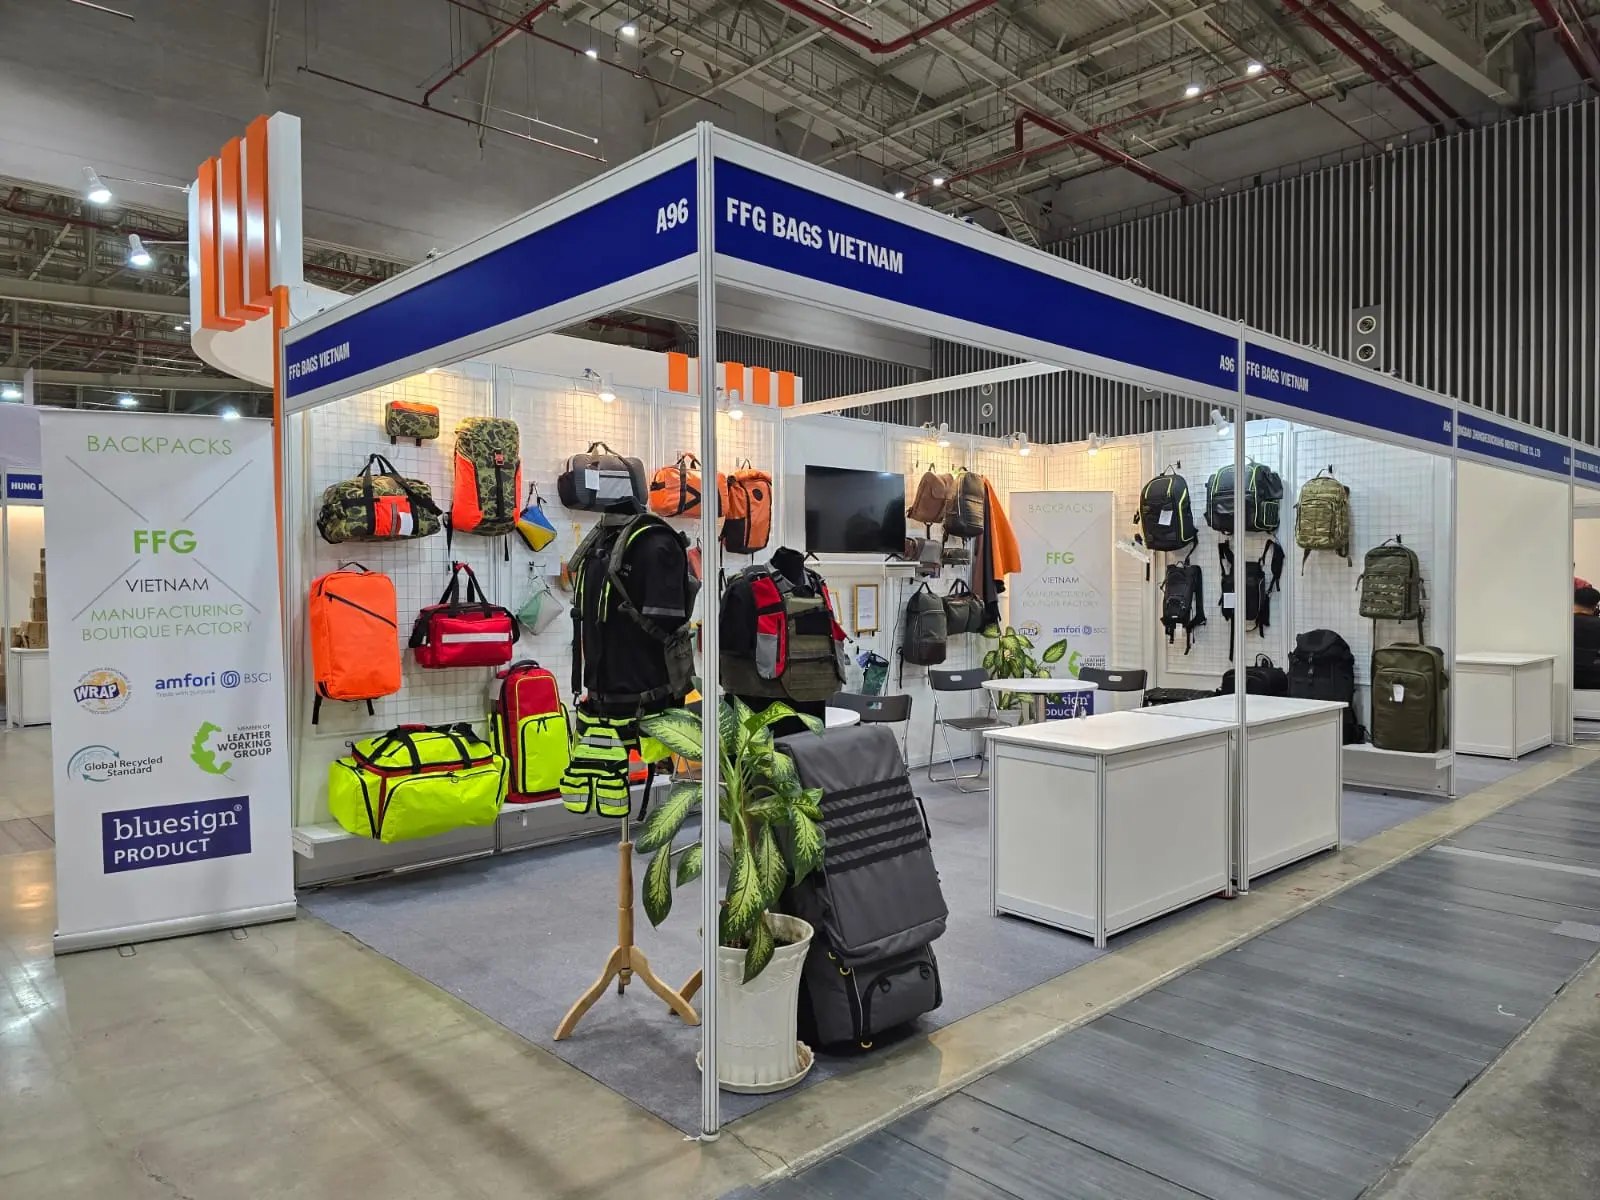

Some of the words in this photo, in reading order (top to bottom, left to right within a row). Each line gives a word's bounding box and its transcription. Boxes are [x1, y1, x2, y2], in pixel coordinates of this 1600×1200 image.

[655, 198, 689, 234] A96
[726, 197, 767, 233] FFG
[772, 212, 823, 249] BAGS
[828, 229, 904, 274] VIETNAM
[288, 362, 301, 380] FFG
[301, 354, 318, 376] BAGS
[319, 341, 350, 369] VIETNAM
[1220, 354, 1235, 373] A96
[1246, 361, 1260, 378] FFG
[1261, 365, 1280, 384] BAGS
[1280, 370, 1309, 392] VIETNAM
[87, 434, 233, 456] BACKPACKS
[11, 481, 37, 491] HUNG
[1028, 503, 1094, 514] BACKPACKS
[133, 529, 198, 554] FFG
[1046, 551, 1075, 565] FFG
[125, 578, 210, 593] VIETNAM
[1041, 576, 1080, 584] VIETNAM
[91, 603, 244, 622] MANUFACTURING
[82, 624, 171, 641] BOUTIQUE
[175, 621, 253, 637] FACTORY
[1053, 624, 1081, 634] amfori
[155, 671, 216, 690] amfori
[244, 672, 272, 684] BSCI
[75, 683, 117, 701] WRAP
[217, 738, 272, 752] WORKING
[227, 730, 271, 742] LEATHER
[233, 747, 272, 759] GROUP
[84, 760, 117, 771] Global
[119, 755, 163, 768] Recycled
[107, 765, 153, 777] Standard
[114, 838, 211, 864] PRODUCT
